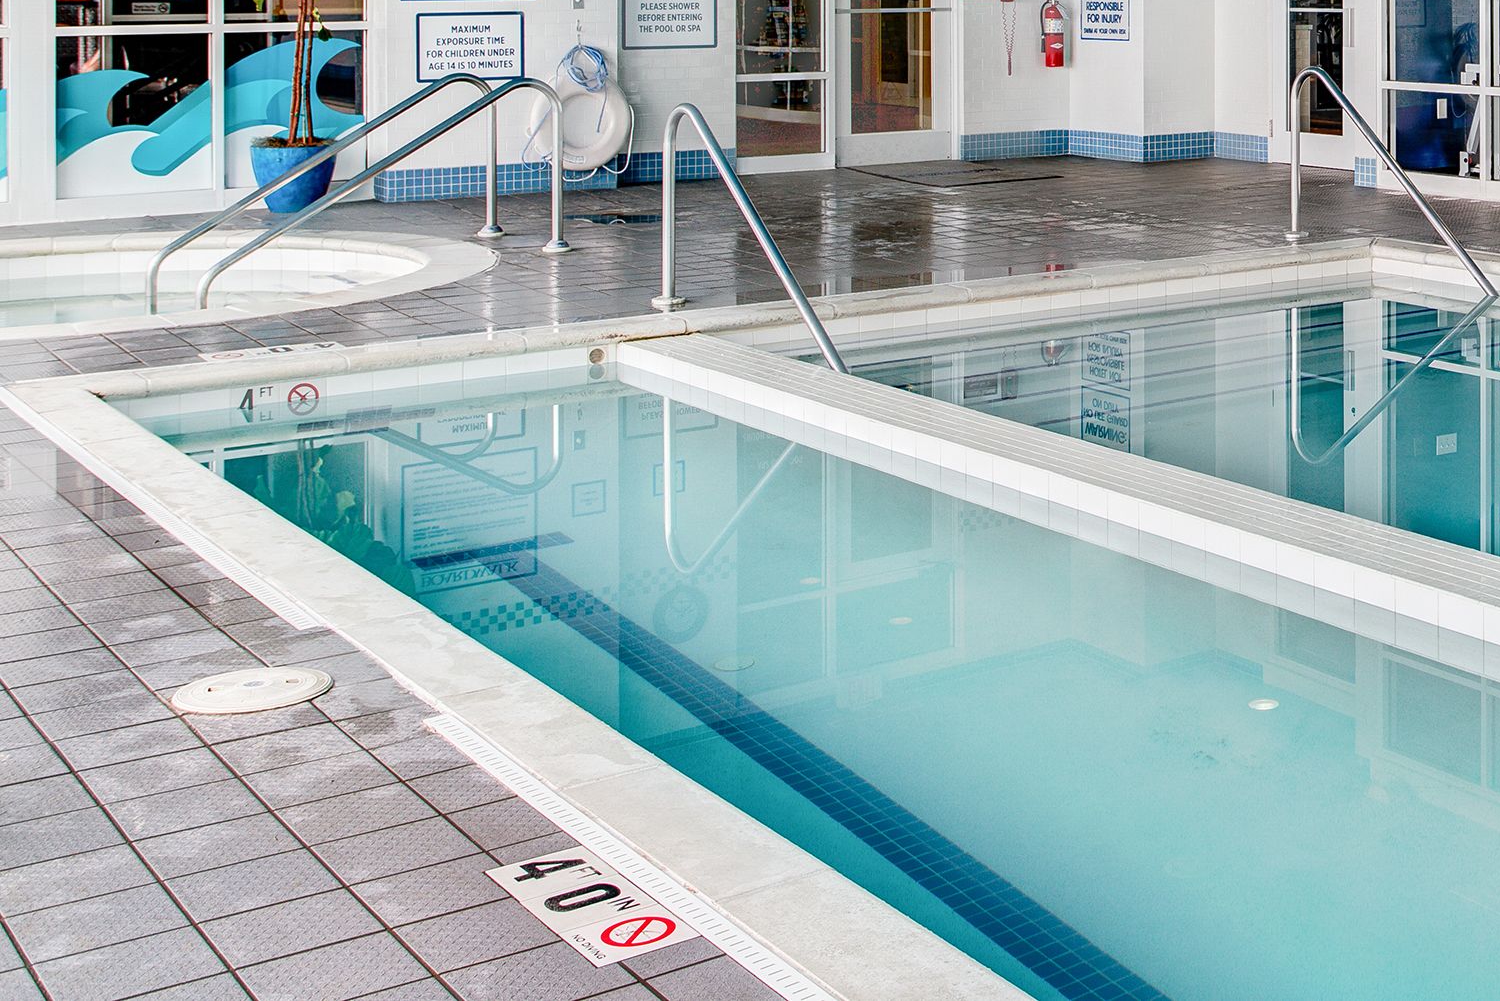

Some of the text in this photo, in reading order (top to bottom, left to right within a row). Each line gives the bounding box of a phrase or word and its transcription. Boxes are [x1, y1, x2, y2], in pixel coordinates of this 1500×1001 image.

[640, 2, 700, 11] PLEASE SHOWER
[1086, 2, 1124, 11] RESPONSIBLE
[638, 13, 703, 22] BEFORE ENTERING
[1087, 14, 1122, 23] FOR INJURY
[451, 25, 491, 33] MAXIMUM
[639, 25, 652, 33] THE
[654, 25, 674, 33] POOL
[436, 37, 484, 46] EXPORSURE
[426, 48, 515, 58] FOR CHILDREN UNDER
[429, 62, 444, 70] AGE
[468, 61, 476, 69] 10
[478, 60, 513, 68] MINUTES
[260, 386, 274, 397] FT
[514, 858, 602, 883] 4 FT
[544, 883, 640, 913] 0 IN
[571, 933, 606, 960] NO DIVING
